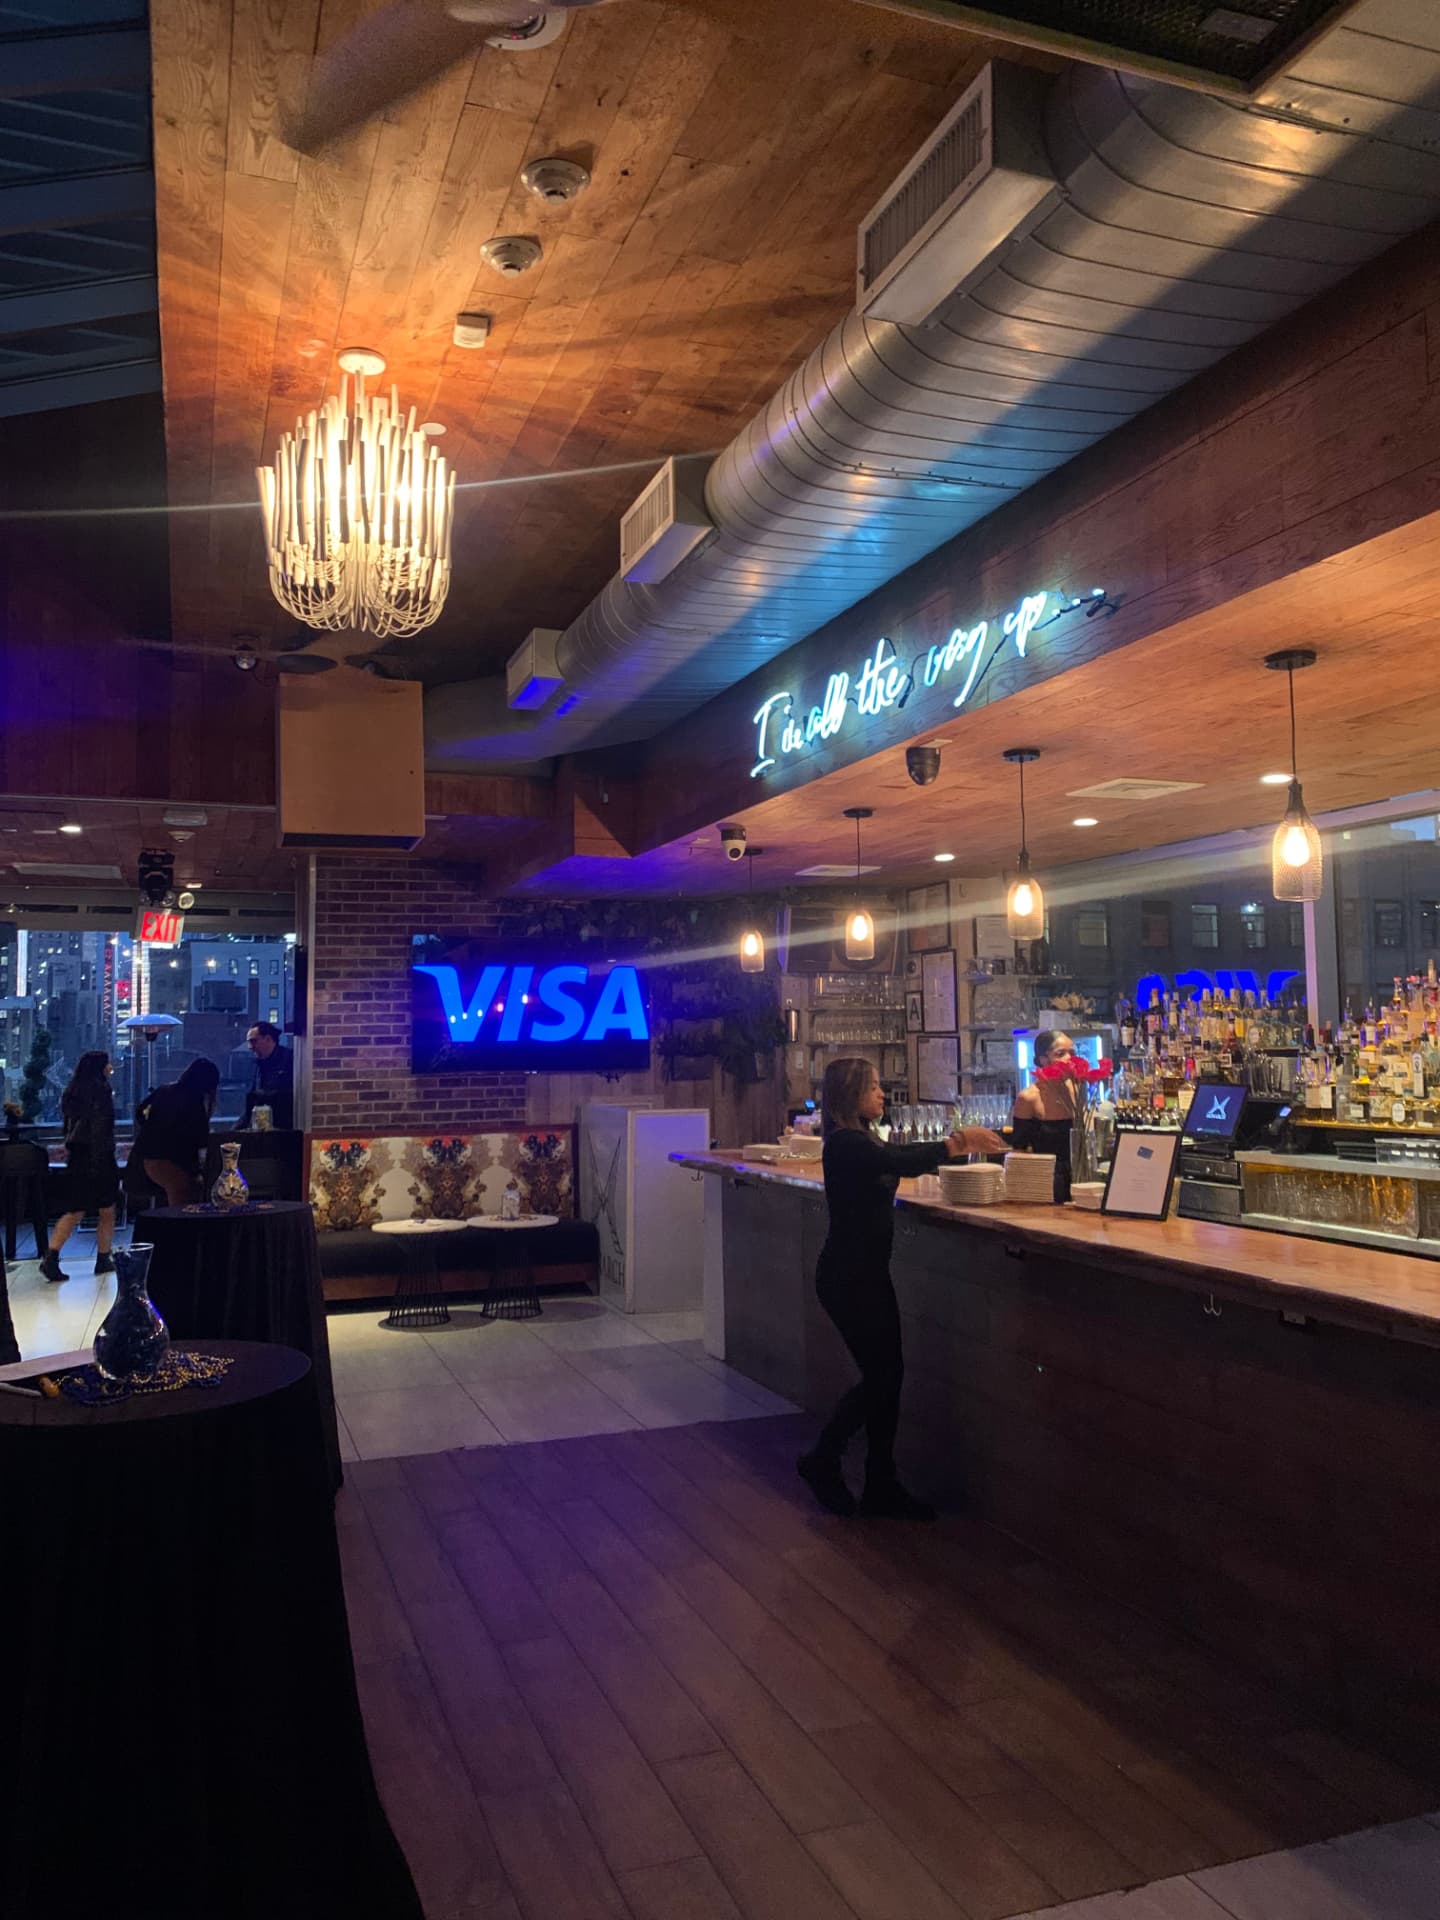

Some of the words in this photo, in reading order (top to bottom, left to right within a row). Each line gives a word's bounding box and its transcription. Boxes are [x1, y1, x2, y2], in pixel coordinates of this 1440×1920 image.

[806, 672, 850, 739] all
[855, 638, 907, 714] the
[924, 621, 988, 708] way
[140, 911, 182, 944] EXIT
[412, 965, 649, 1042] VISA
[909, 997, 920, 1020] A
